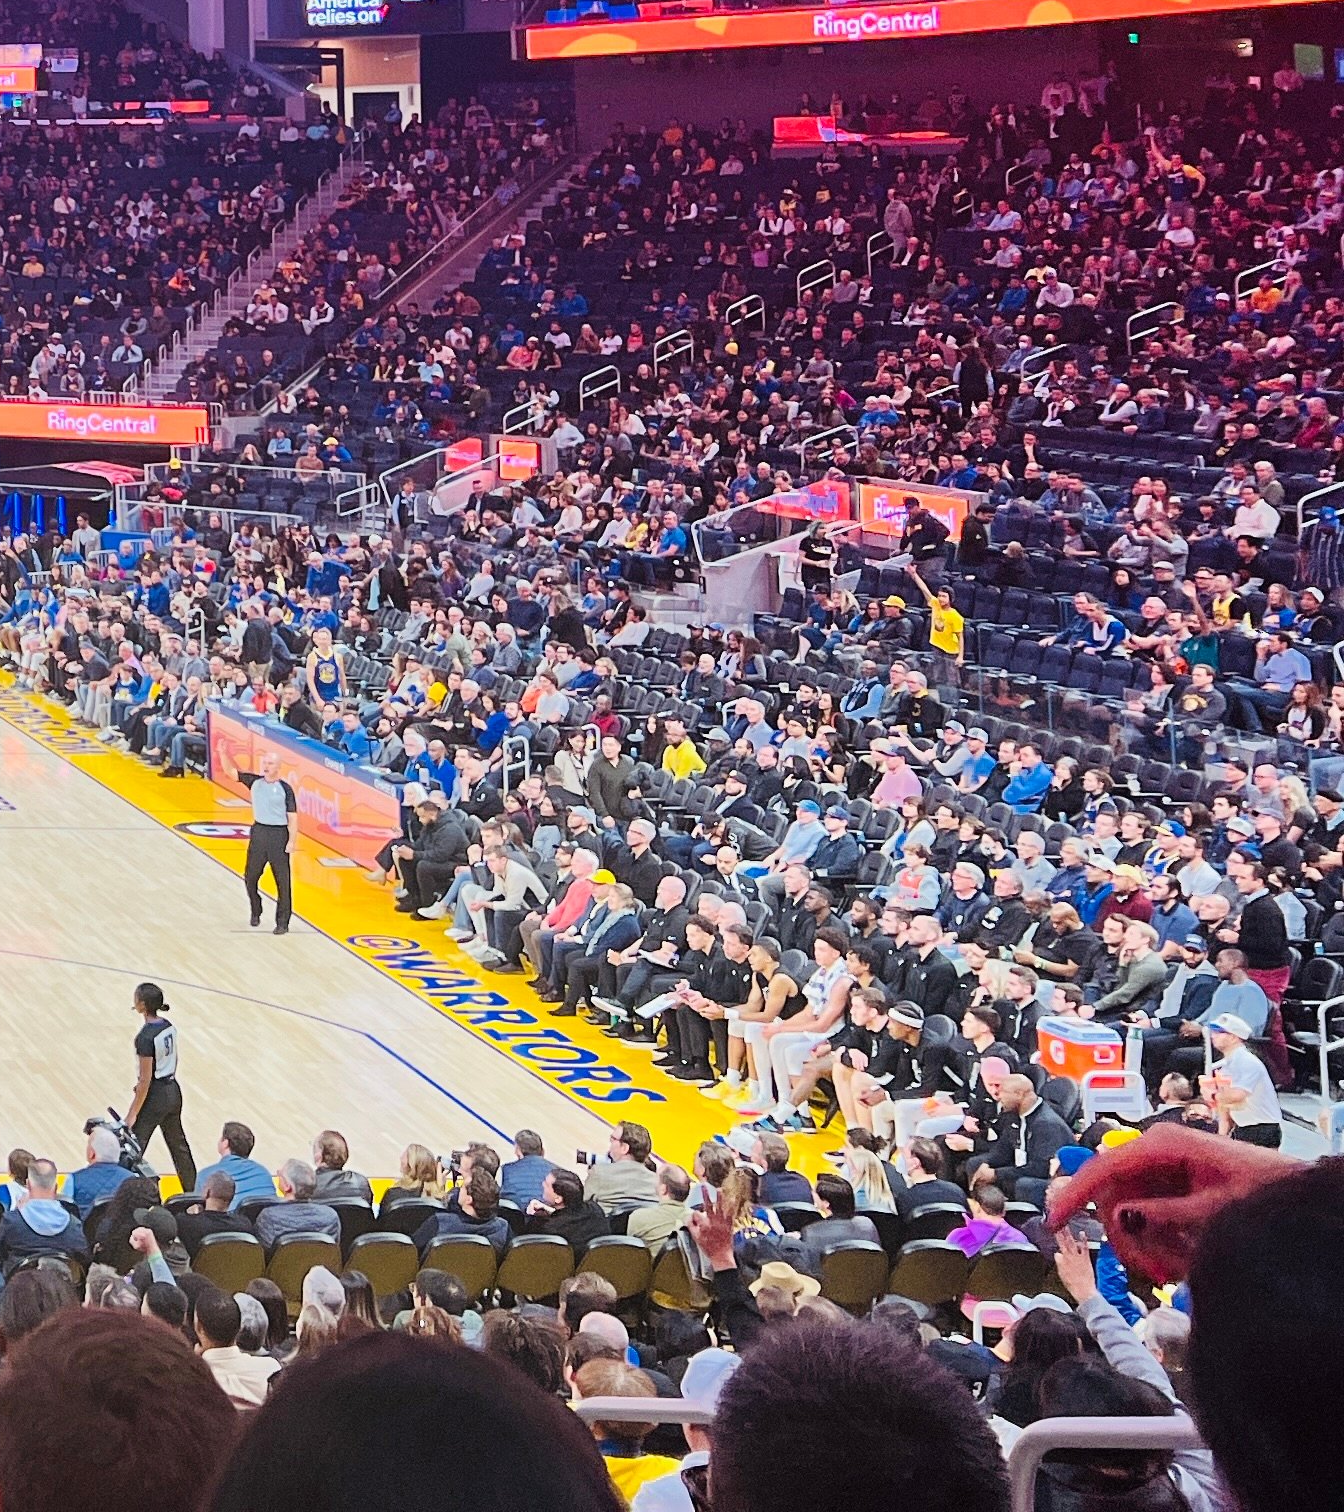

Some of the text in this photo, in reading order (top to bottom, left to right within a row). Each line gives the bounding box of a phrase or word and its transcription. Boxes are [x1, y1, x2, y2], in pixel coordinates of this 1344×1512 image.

[307, 9, 381, 26] relies on
[813, 7, 939, 39] RingCentral
[48, 409, 155, 435] RingCentral
[346, 934, 667, 1103] @WARRIORS
